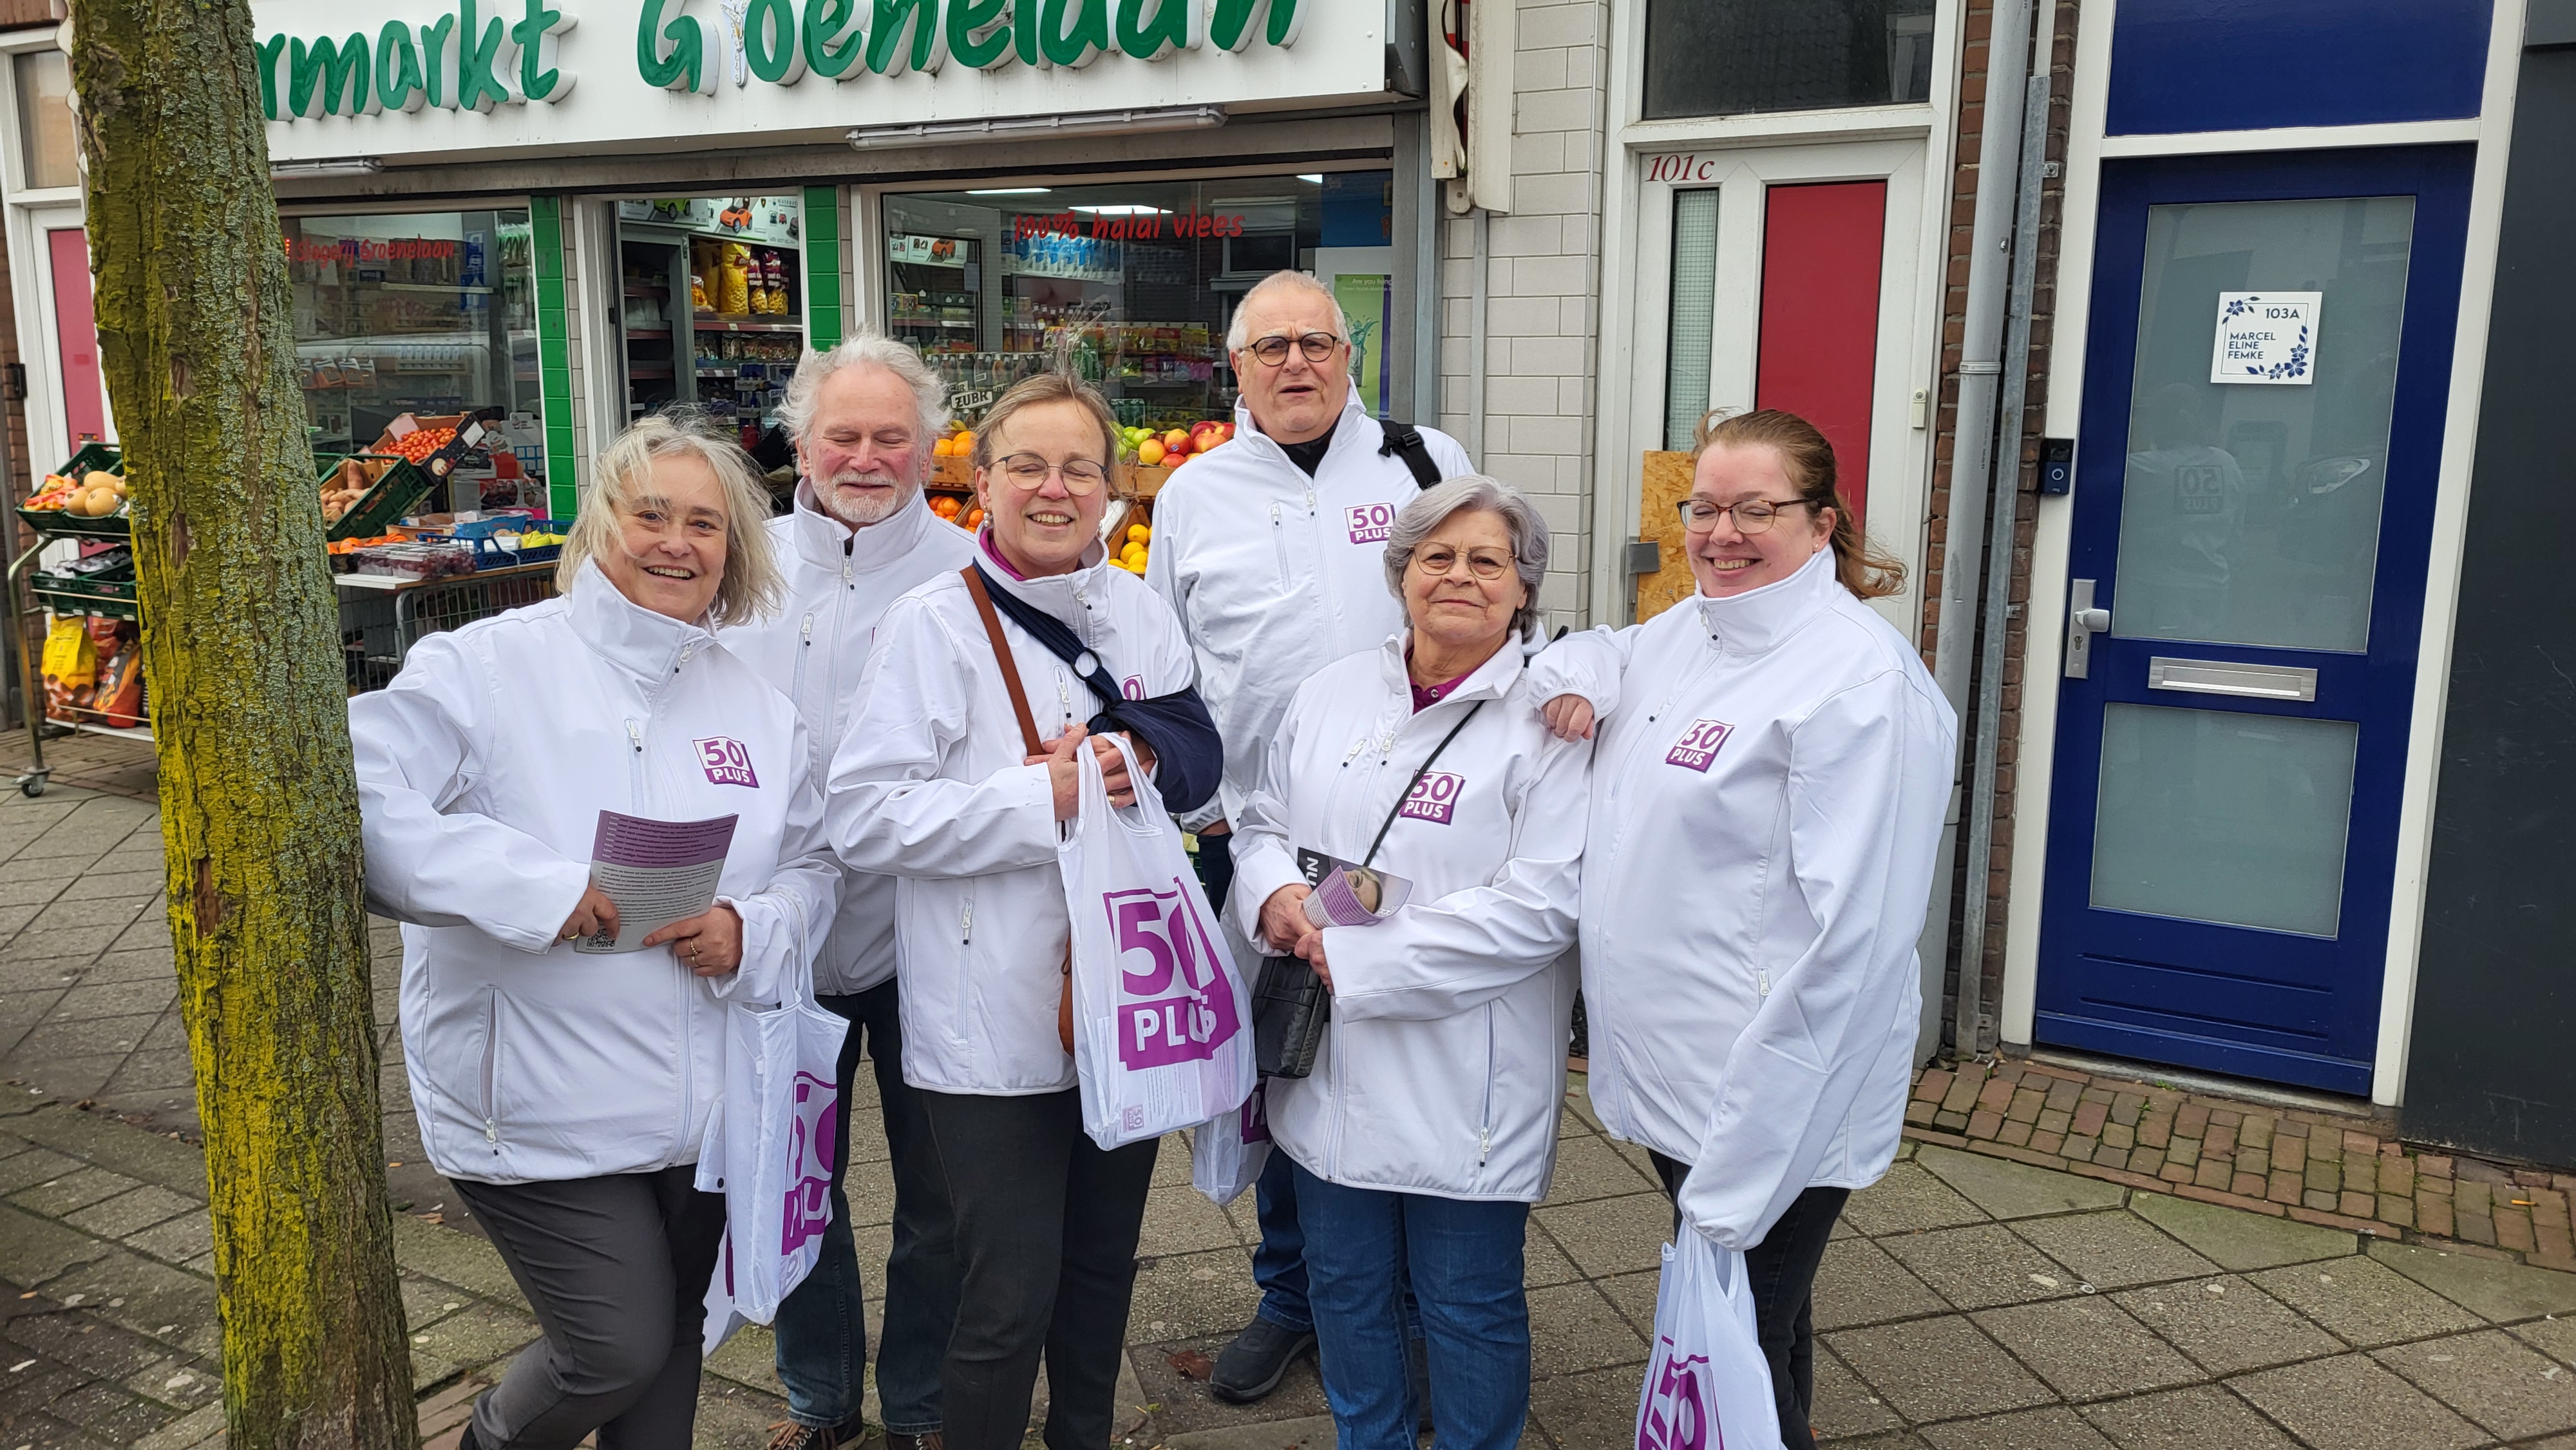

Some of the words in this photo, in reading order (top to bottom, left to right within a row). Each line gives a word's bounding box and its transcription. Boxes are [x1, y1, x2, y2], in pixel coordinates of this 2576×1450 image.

[1014, 210, 1079, 241] 100%
[1092, 207, 1162, 240] halal
[1173, 205, 1244, 238] vlees
[360, 233, 454, 260] Groenelaan
[2266, 308, 2300, 319] 103A
[2230, 332, 2276, 341] MARCEL
[2228, 351, 2264, 359] FEMKE
[1353, 505, 1389, 529] 50
[1355, 528, 1391, 541] PLUS
[1681, 722, 1726, 749] 50
[703, 740, 744, 767] 50
[1670, 748, 1706, 766] PLUS
[712, 767, 750, 783] PLUS
[1410, 775, 1454, 801] 50
[1404, 801, 1444, 818] PLUS
